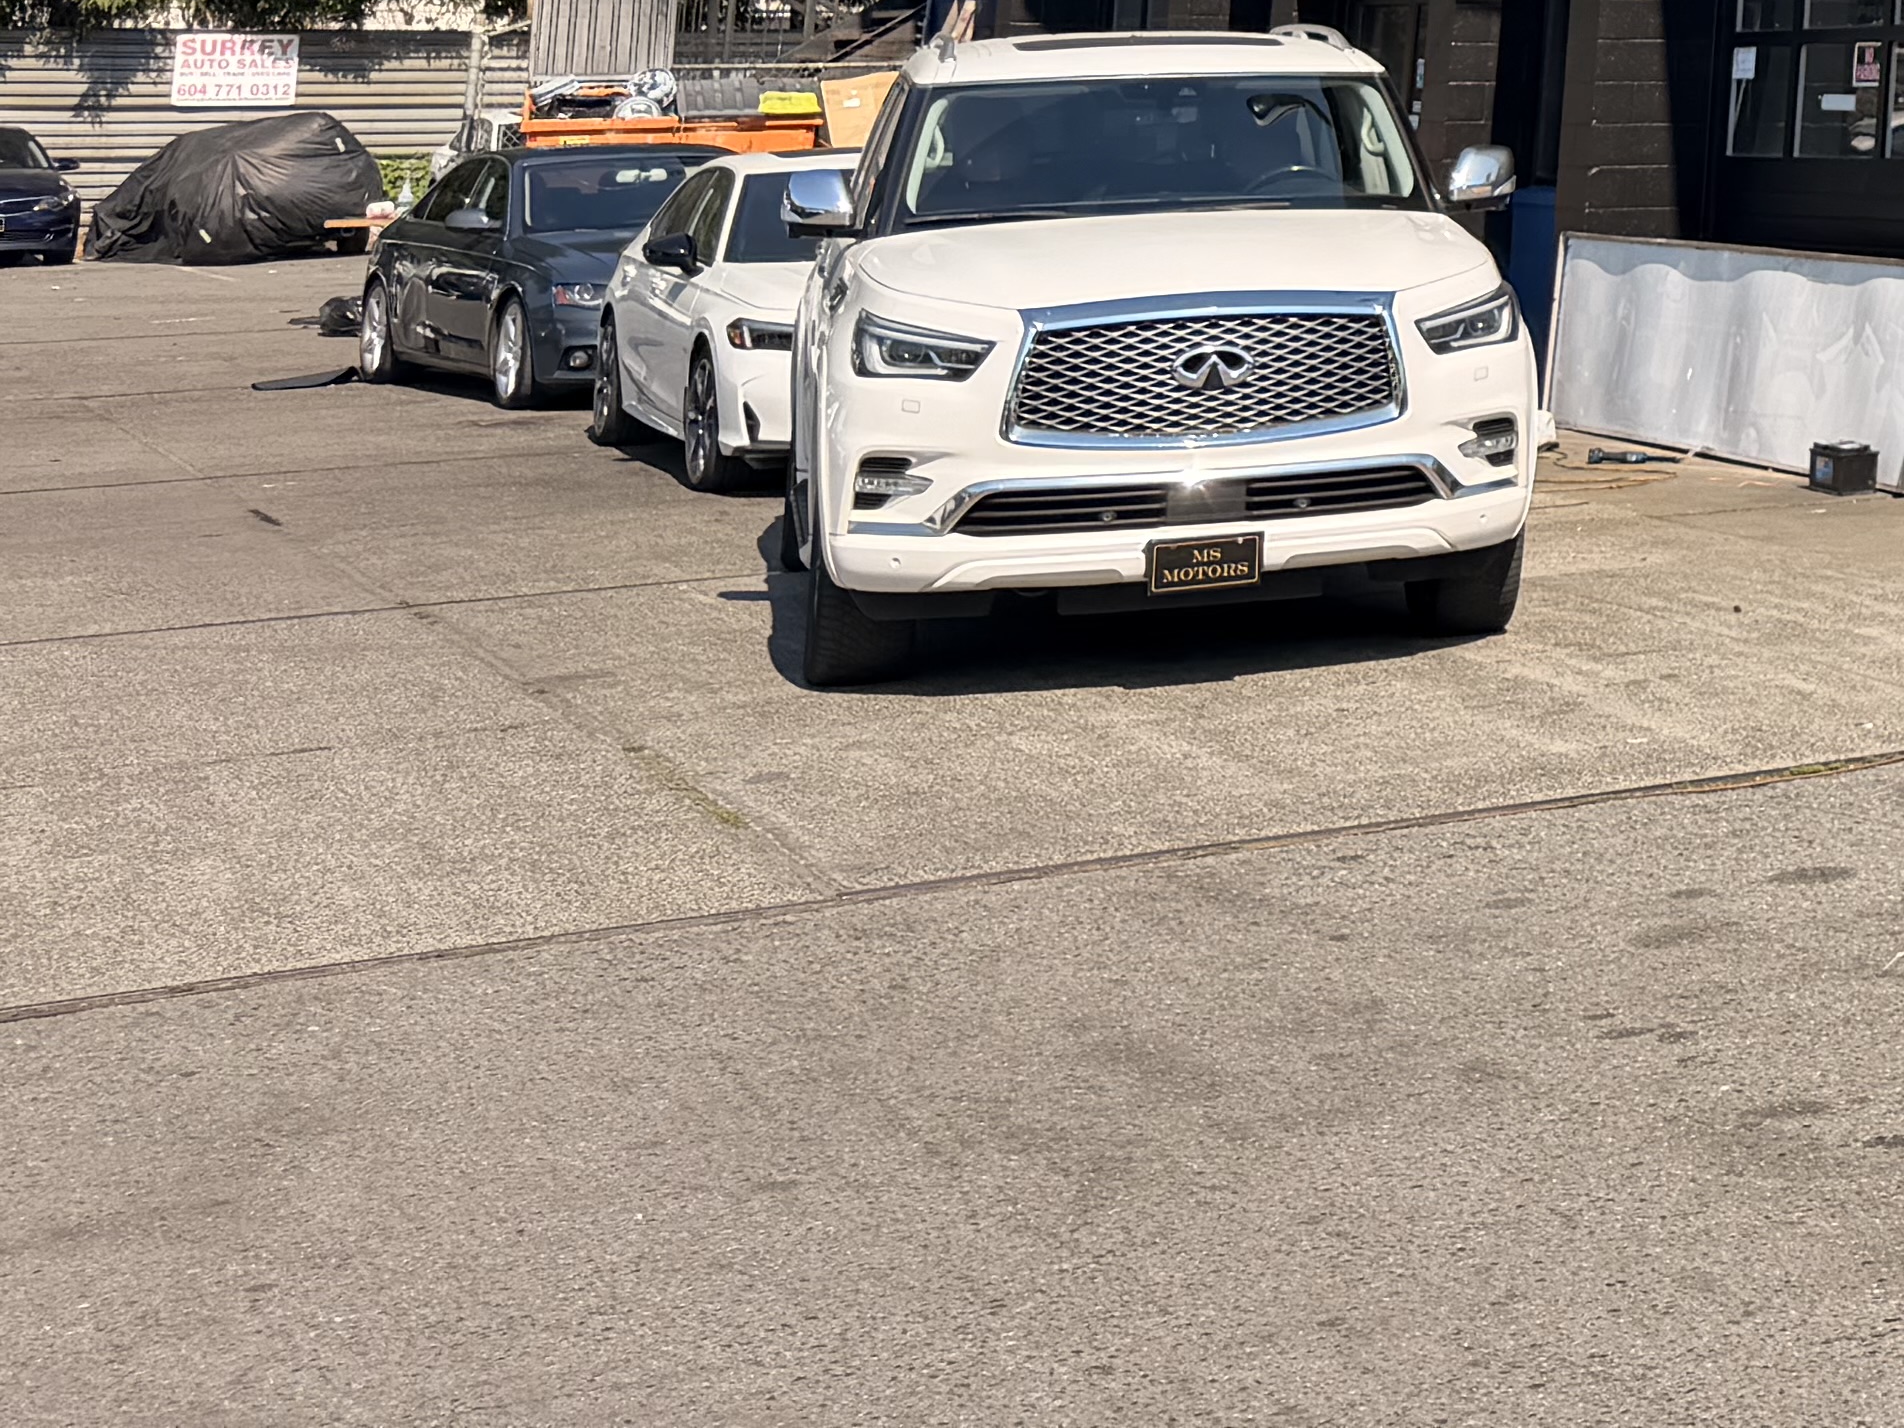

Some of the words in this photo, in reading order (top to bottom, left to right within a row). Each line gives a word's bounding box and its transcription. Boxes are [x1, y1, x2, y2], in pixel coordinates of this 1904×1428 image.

[181, 58, 230, 70] AUTO
[236, 58, 293, 70] SALES
[176, 83, 208, 97] 604
[213, 83, 243, 97] 771
[249, 83, 291, 96] 0312
[1192, 547, 1222, 563] MS
[1162, 562, 1250, 583] MOTORS
